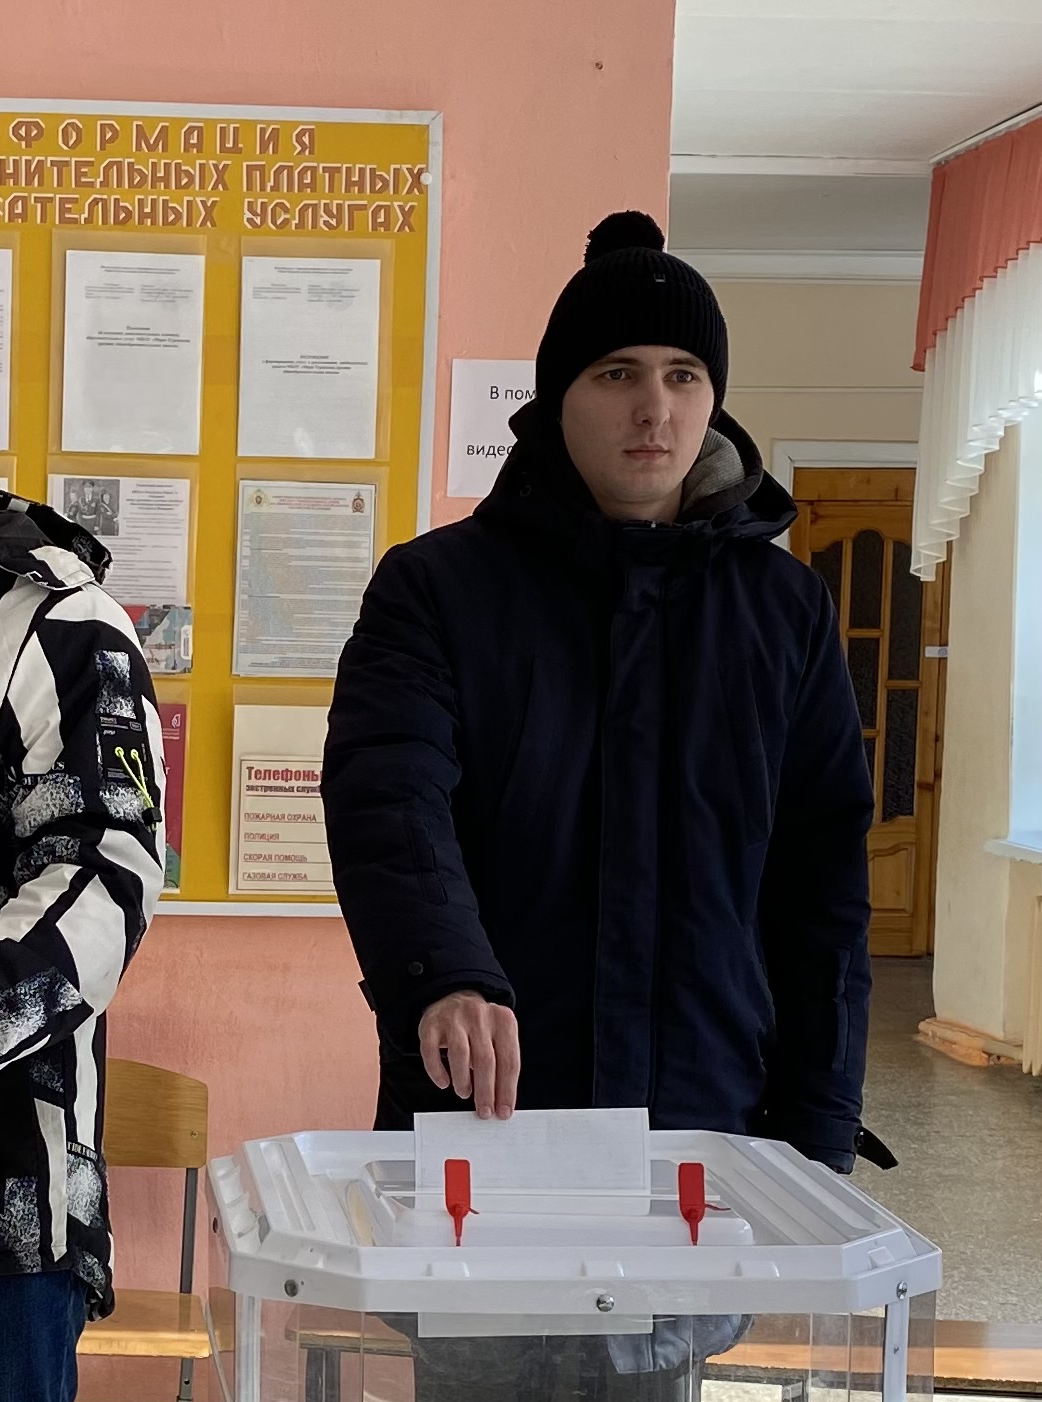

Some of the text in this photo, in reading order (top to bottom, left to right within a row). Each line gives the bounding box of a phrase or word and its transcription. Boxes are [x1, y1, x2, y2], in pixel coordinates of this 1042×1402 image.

[243, 161, 426, 195] ПЛАТНЫХ
[243, 198, 418, 233] УСЛУГАХ
[490, 386, 499, 399] В
[244, 812, 317, 822] ПОЖАРНАЯ ОХРАНА
[244, 832, 280, 841] ПОЛИЦИЯ
[243, 853, 308, 863] СКОРАЯ ПОМОЩЬ
[243, 872, 308, 881] ГАЗОВАЯ СЛУЖБА
